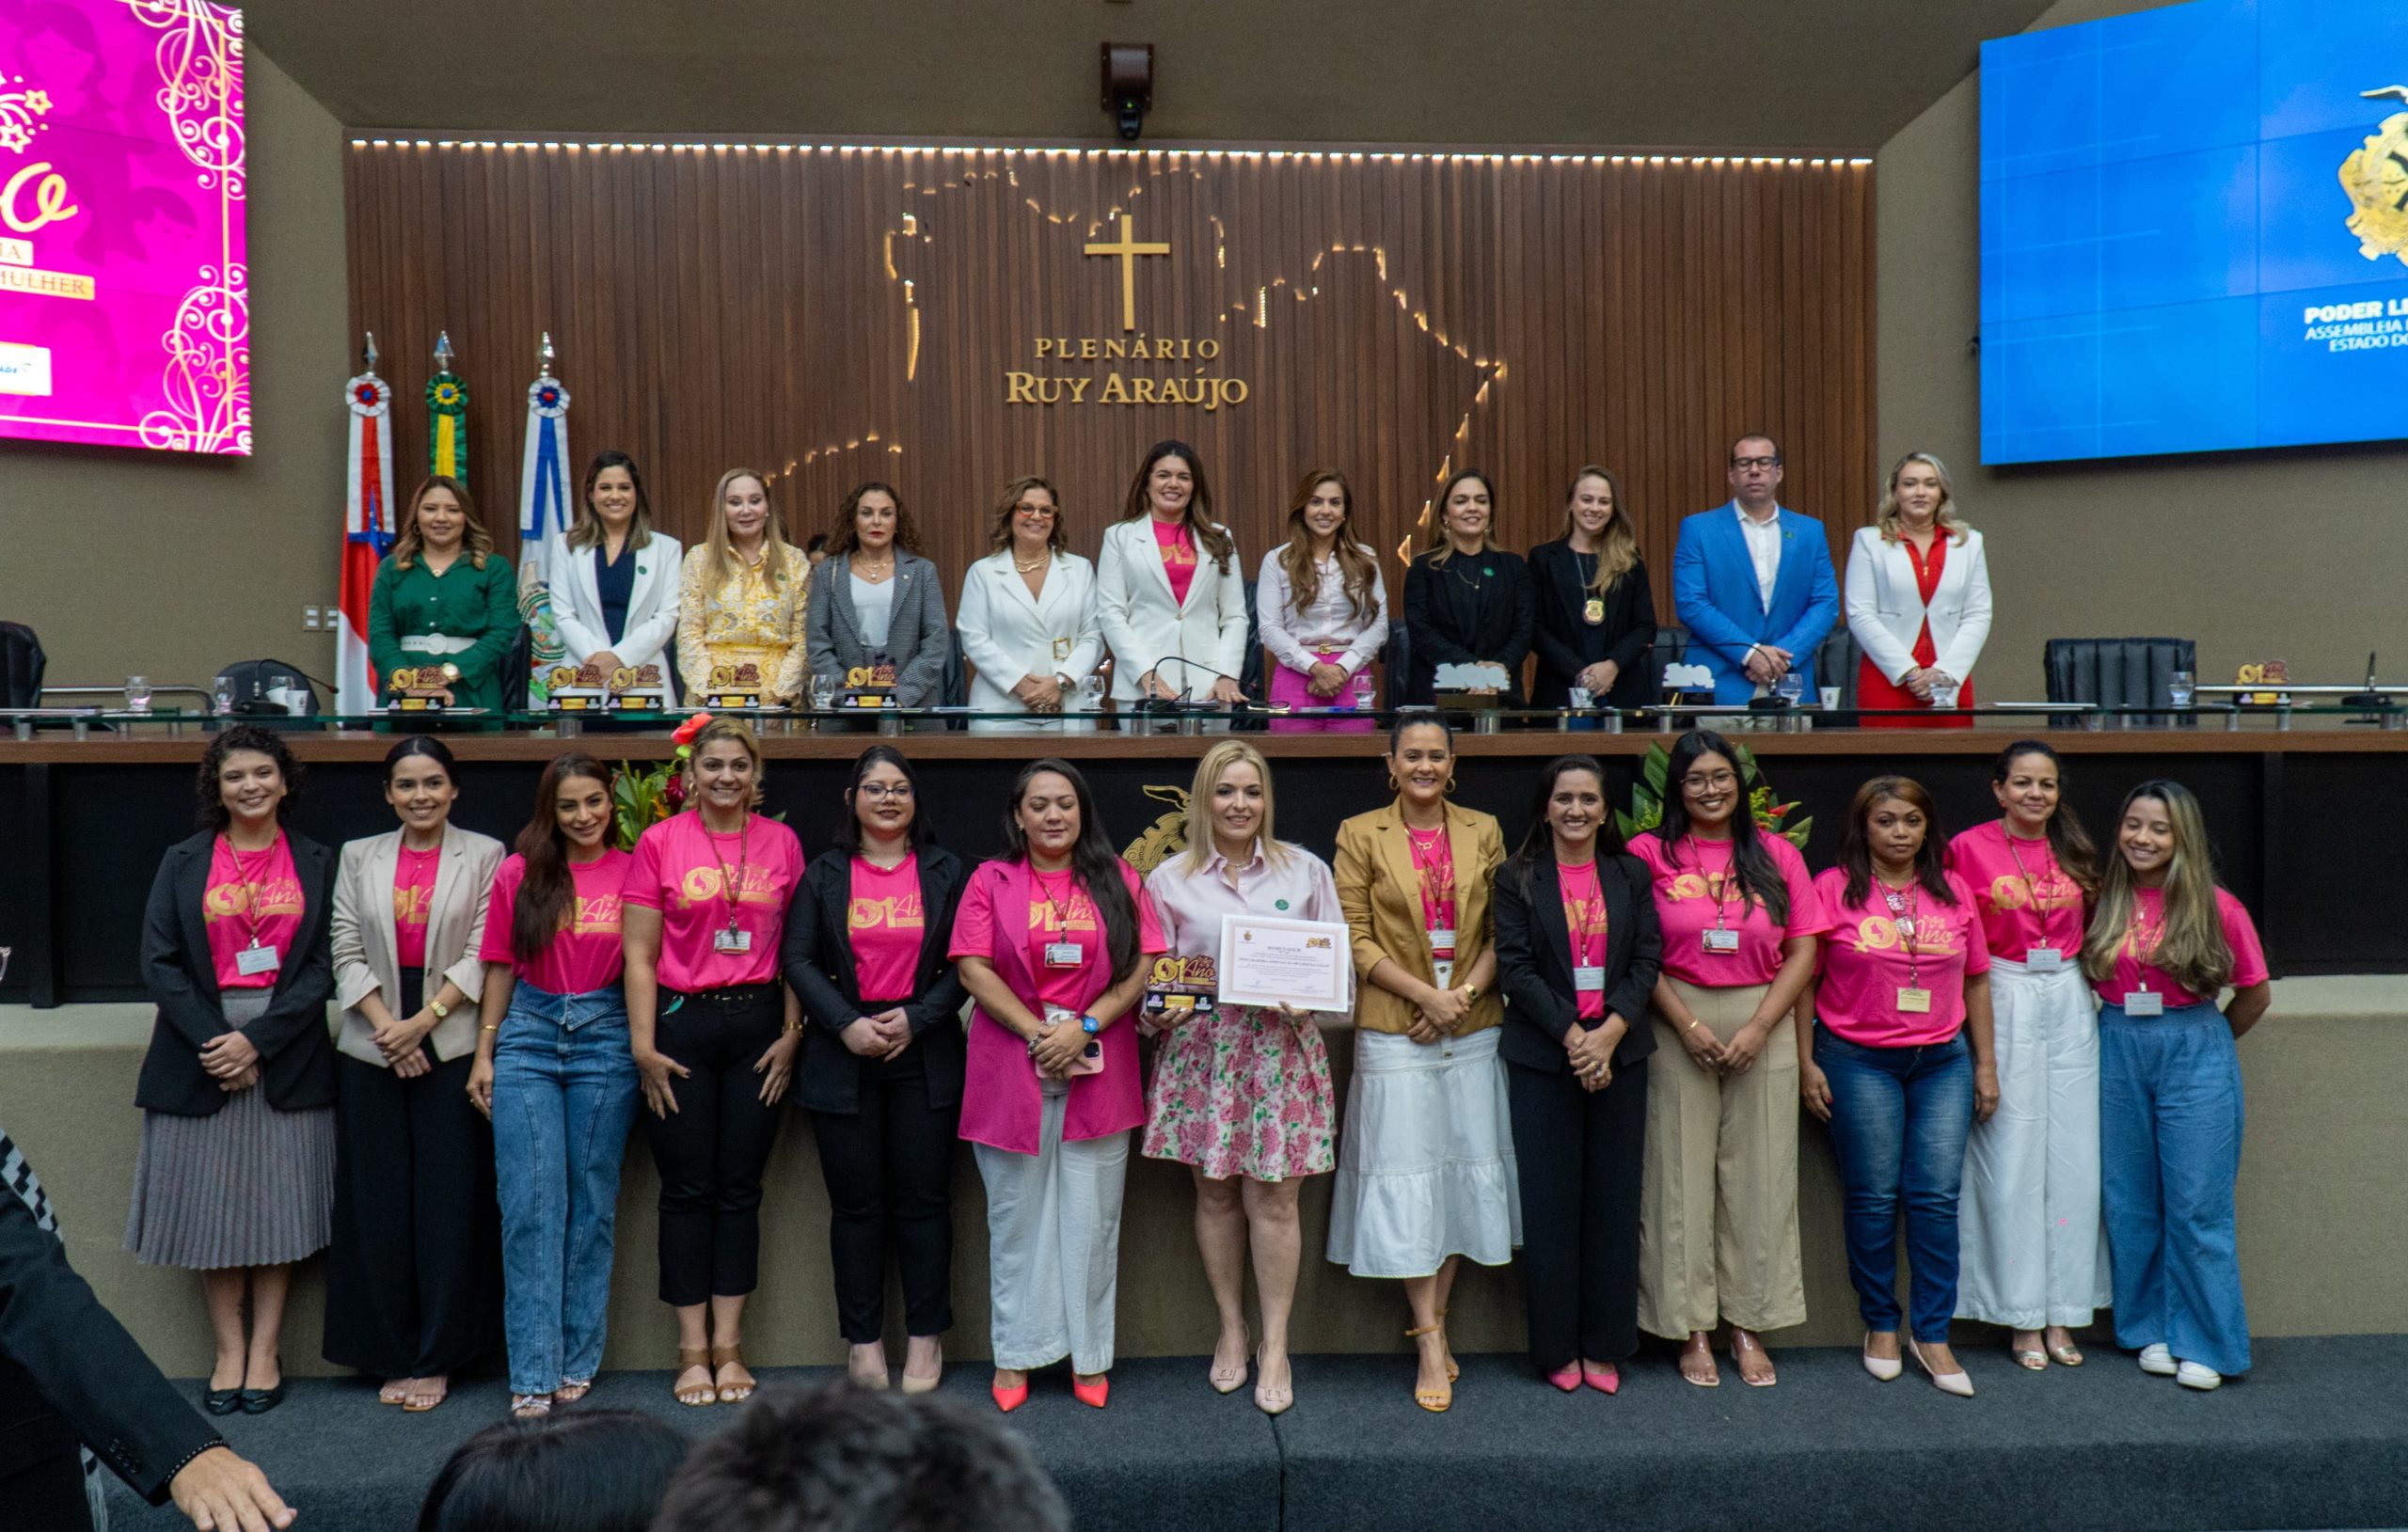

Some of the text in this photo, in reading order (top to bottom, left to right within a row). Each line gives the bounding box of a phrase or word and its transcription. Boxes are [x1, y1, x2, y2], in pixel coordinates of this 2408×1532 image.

[2305, 301, 2384, 324] PODER
[2305, 319, 2402, 340] ASSEMBLEIA
[1035, 333, 1220, 359] PLENÁRIO
[2329, 335, 2389, 352] ESTADO
[1006, 371, 1091, 403] RUY
